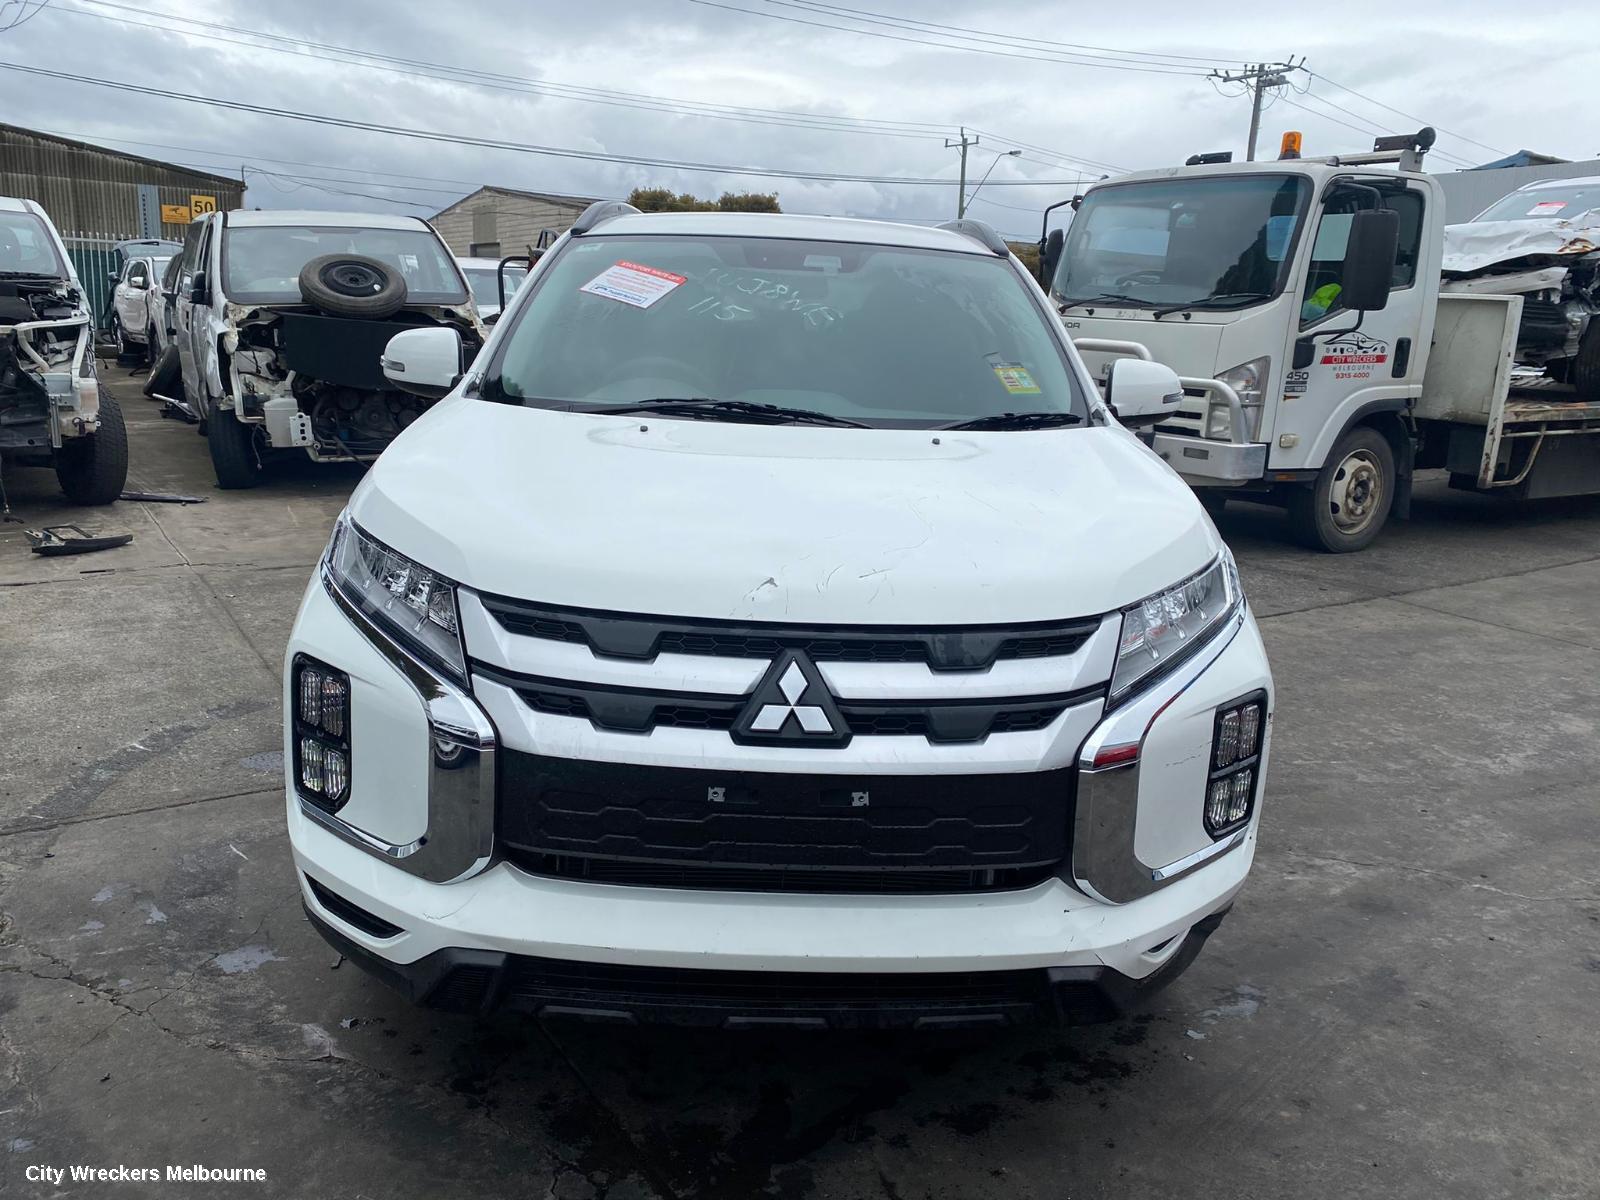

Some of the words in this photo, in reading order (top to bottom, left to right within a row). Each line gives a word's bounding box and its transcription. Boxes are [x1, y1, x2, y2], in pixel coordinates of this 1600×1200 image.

[194, 200, 214, 214] 50
[1332, 355, 1346, 363] CITY
[1347, 355, 1377, 363] WRECKERS
[1286, 371, 1309, 380] 450
